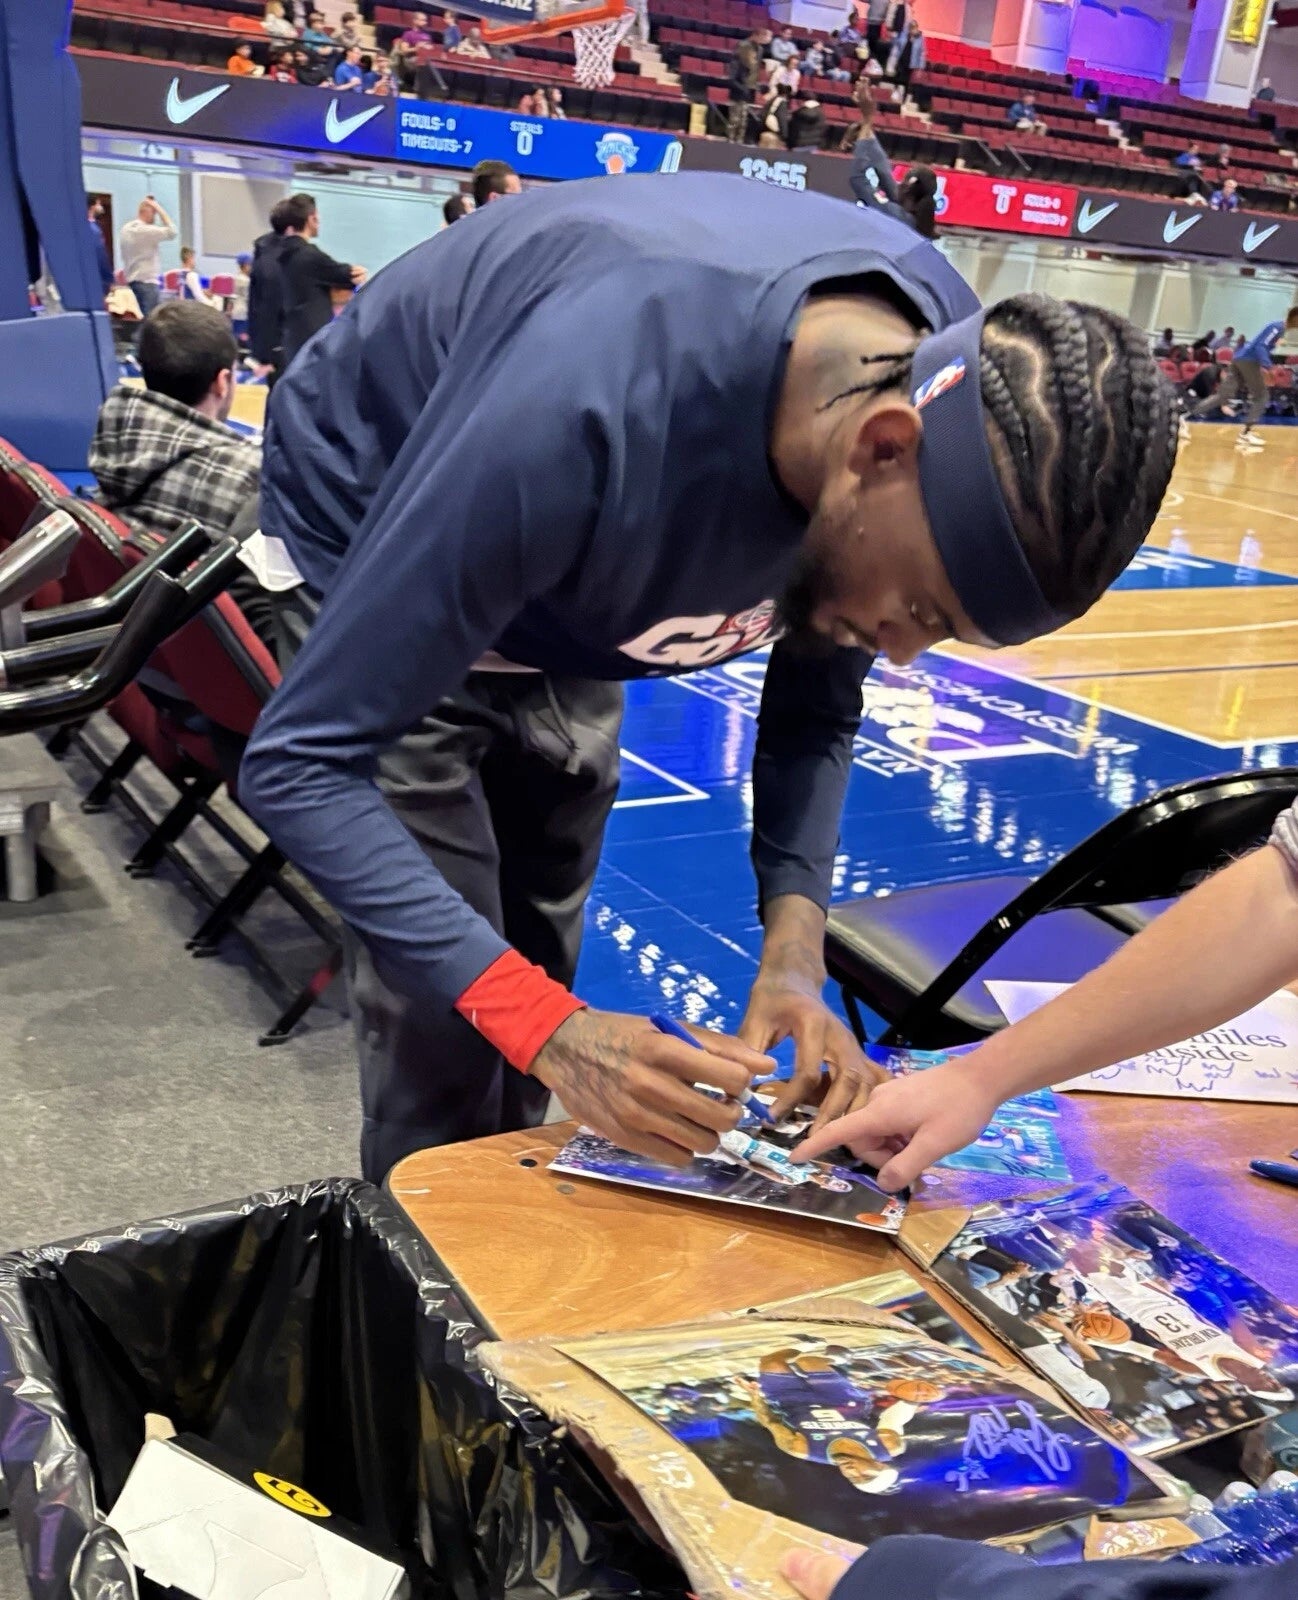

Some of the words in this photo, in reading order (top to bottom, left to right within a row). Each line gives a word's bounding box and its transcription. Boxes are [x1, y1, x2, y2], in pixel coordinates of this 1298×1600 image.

[517, 131, 533, 155] 0
[1145, 1045, 1253, 1062] nside
[1154, 1312, 1191, 1334] 13
